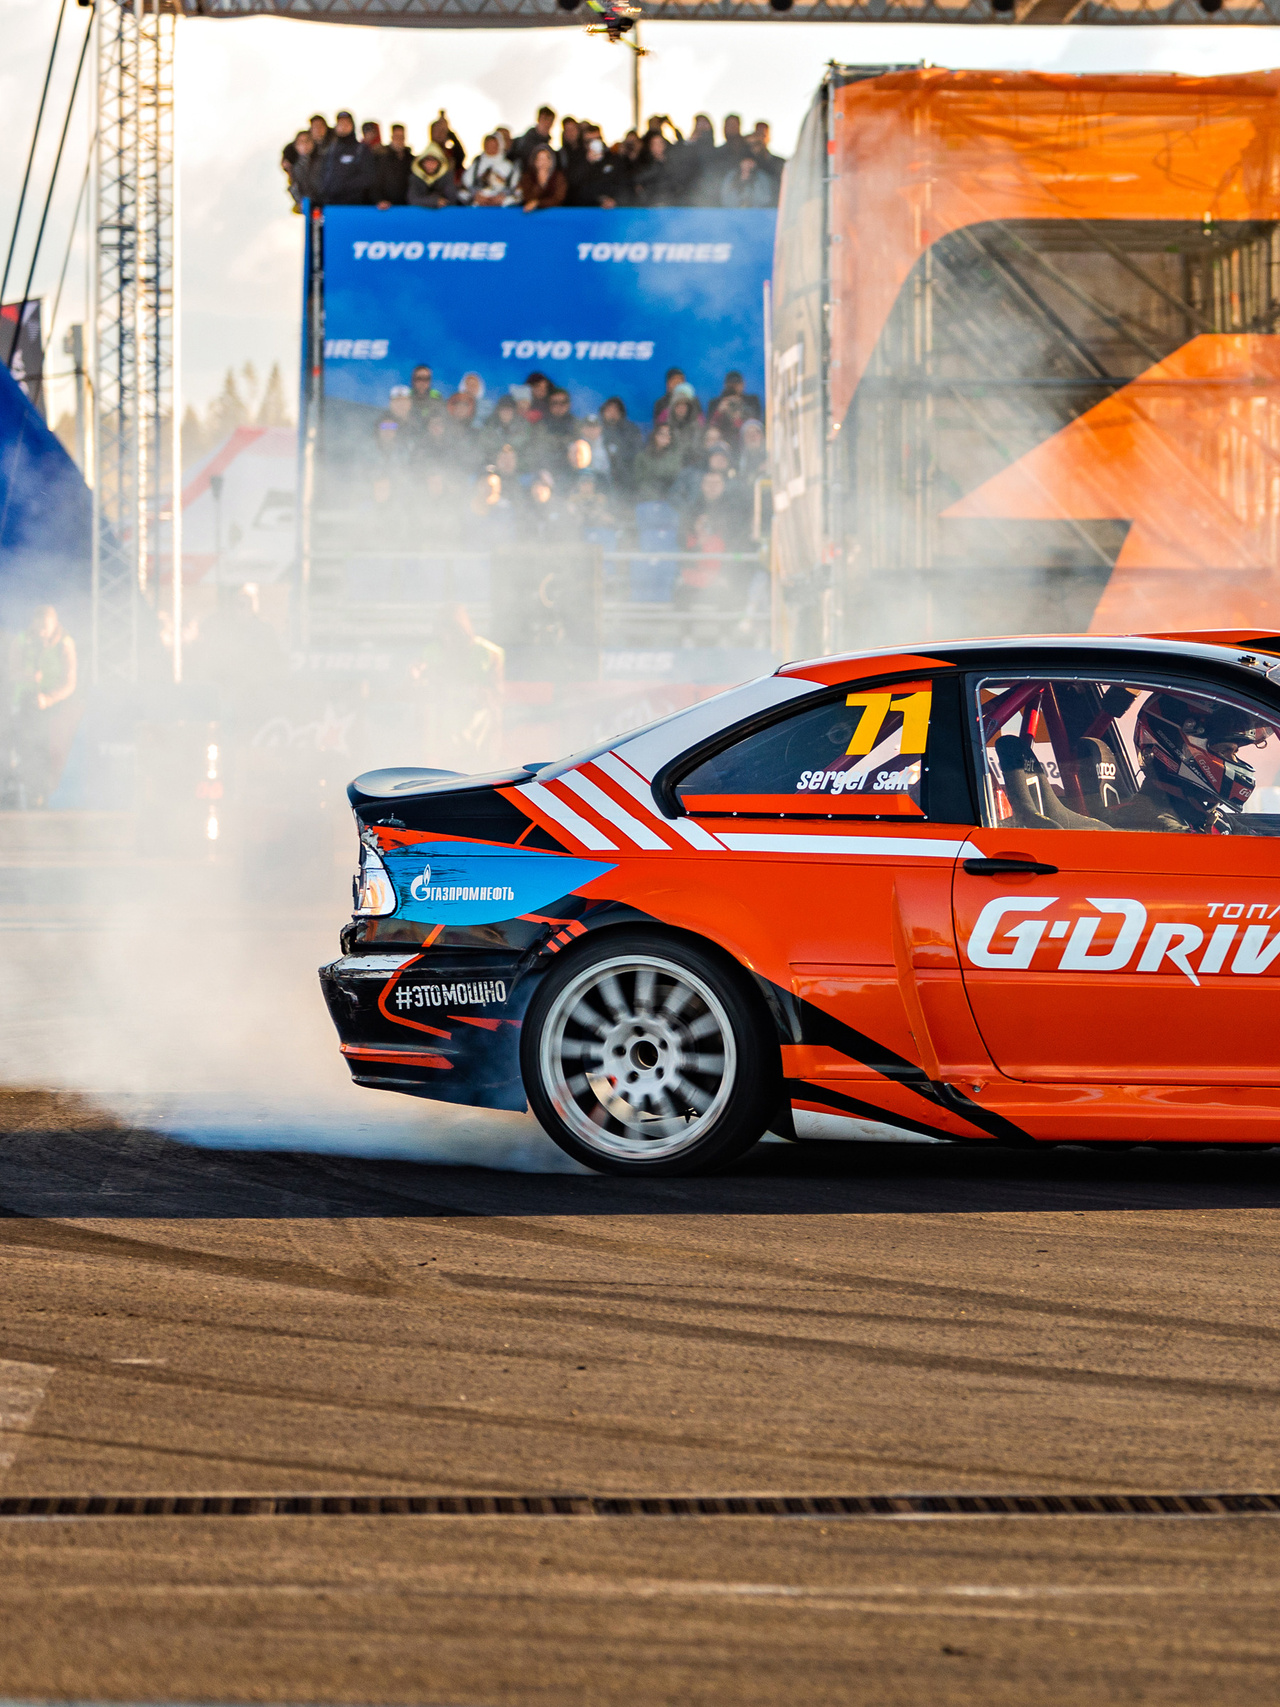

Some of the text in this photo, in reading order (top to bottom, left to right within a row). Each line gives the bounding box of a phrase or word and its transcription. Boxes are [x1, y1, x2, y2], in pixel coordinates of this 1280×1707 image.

[353, 241, 507, 261] TOYO TIRES
[578, 243, 732, 263] TOYO TIRES
[324, 339, 389, 360] IRES
[501, 340, 655, 361] TOYO TIRES
[603, 651, 675, 671] IRES
[845, 691, 932, 756] 71
[796, 766, 909, 795] sergei sak
[395, 980, 507, 1009] #ЭТОМОЩНО
